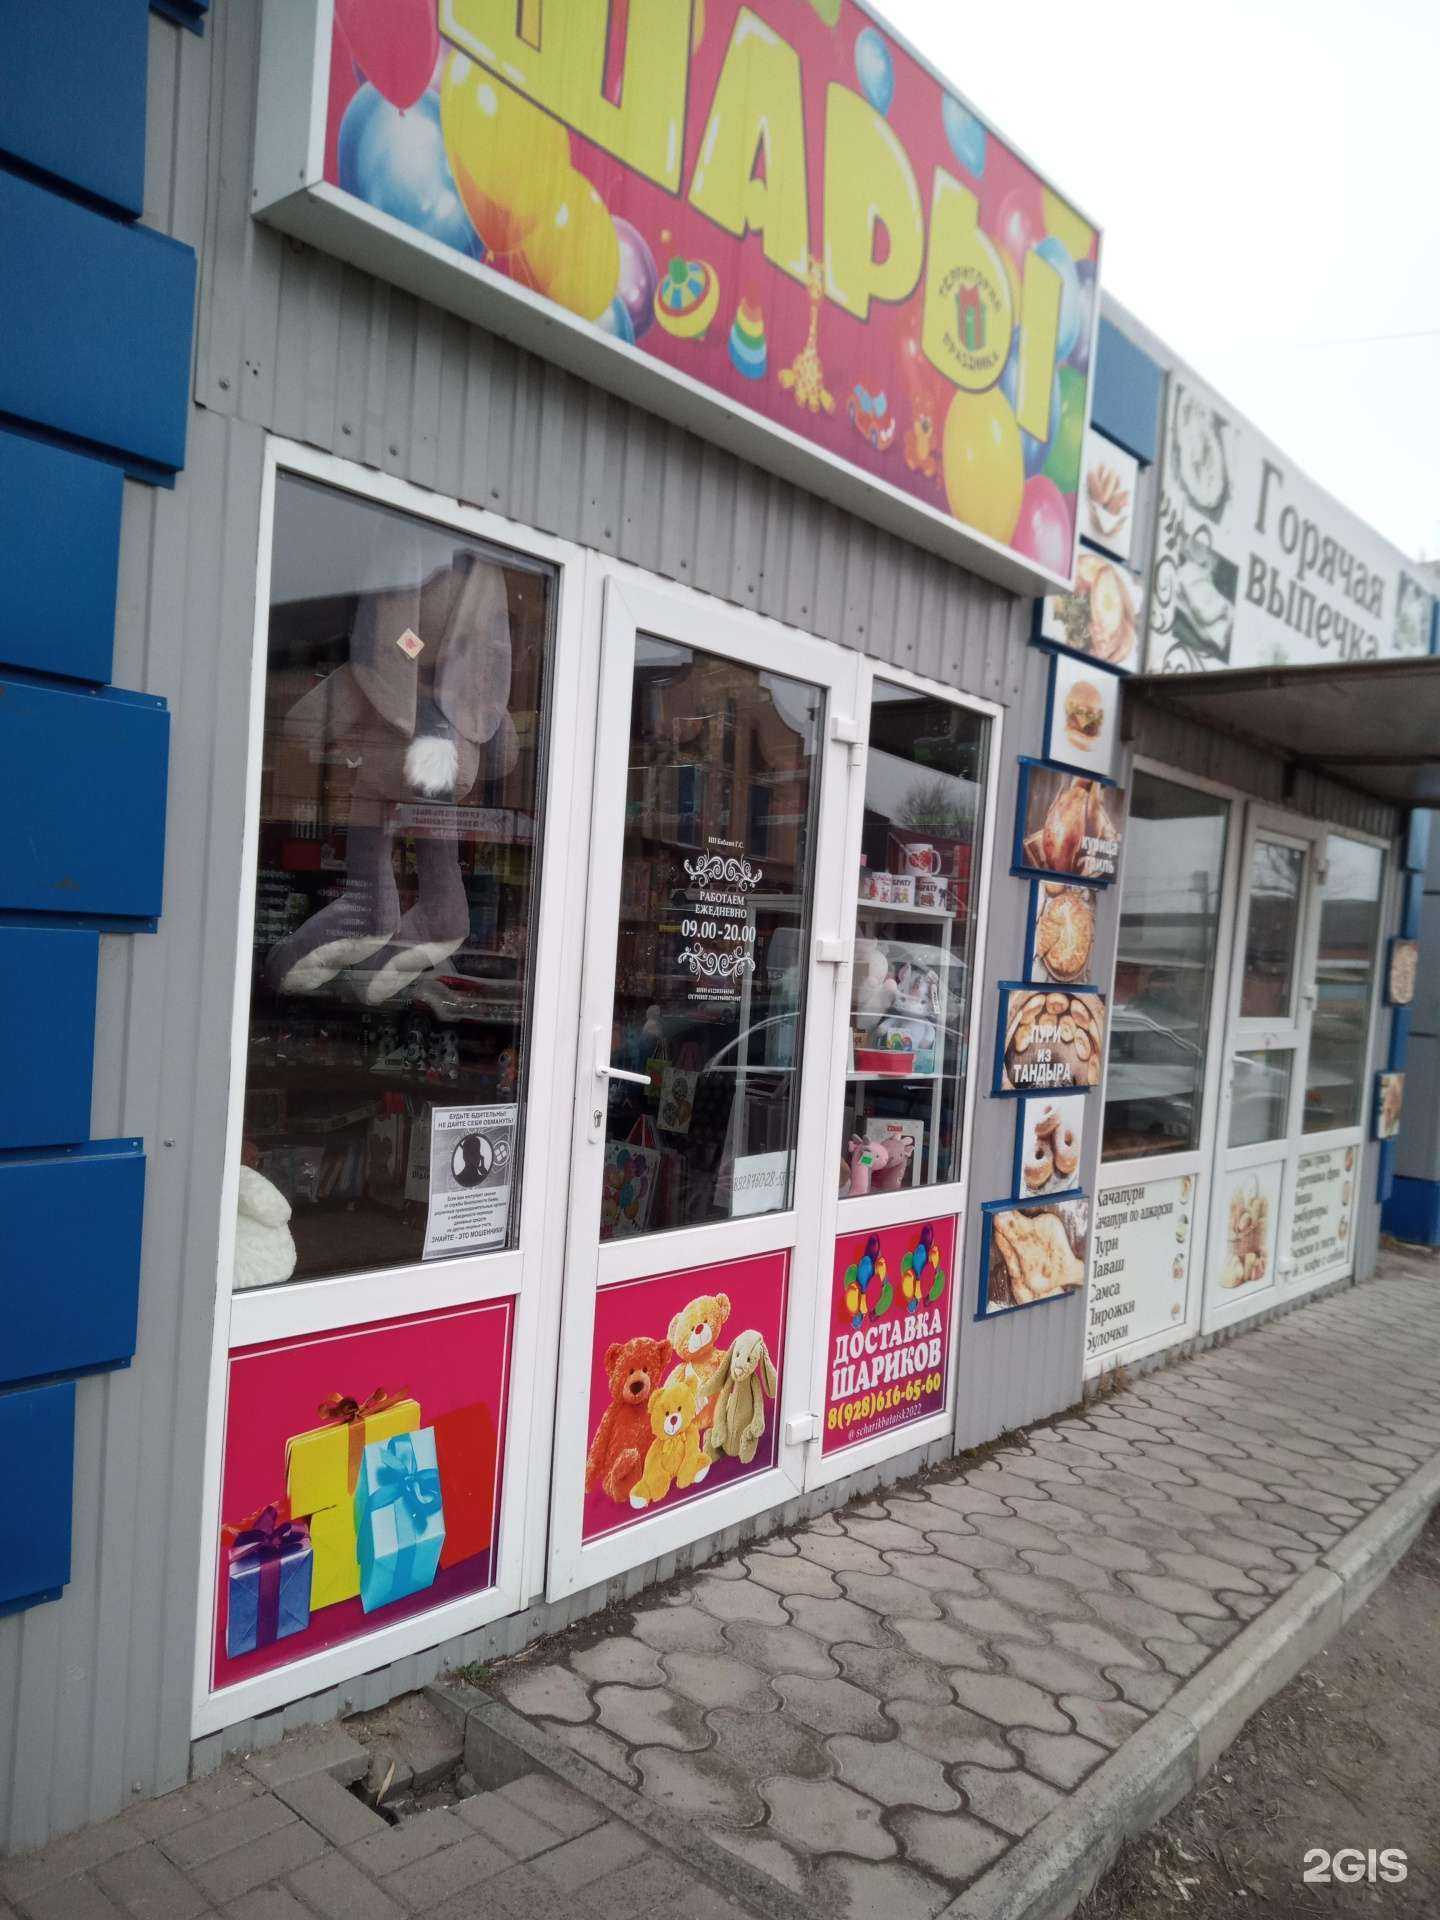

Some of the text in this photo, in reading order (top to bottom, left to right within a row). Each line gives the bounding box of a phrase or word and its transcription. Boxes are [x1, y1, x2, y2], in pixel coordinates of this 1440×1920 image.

[1255, 457, 1387, 620] Горячая
[1245, 552, 1380, 660] выпечка
[699, 890, 745, 906] РАБОТАЕМ
[695, 905, 747, 919] ЕЖЕДНЕВНО
[1013, 1063, 1072, 1085] ТАНДЫРА
[447, 1120, 466, 1128] ДАЙТЕ
[1096, 1210, 1128, 1231] ачапури
[432, 1234, 454, 1243] ЗНАЙТЕ
[459, 1231, 469, 1239] ЭТО
[833, 1308, 943, 1368] ДОСТАВКА
[830, 1338, 942, 1401] ШАРИКОВ
[827, 1372, 941, 1430] 8(928)616-65-60
